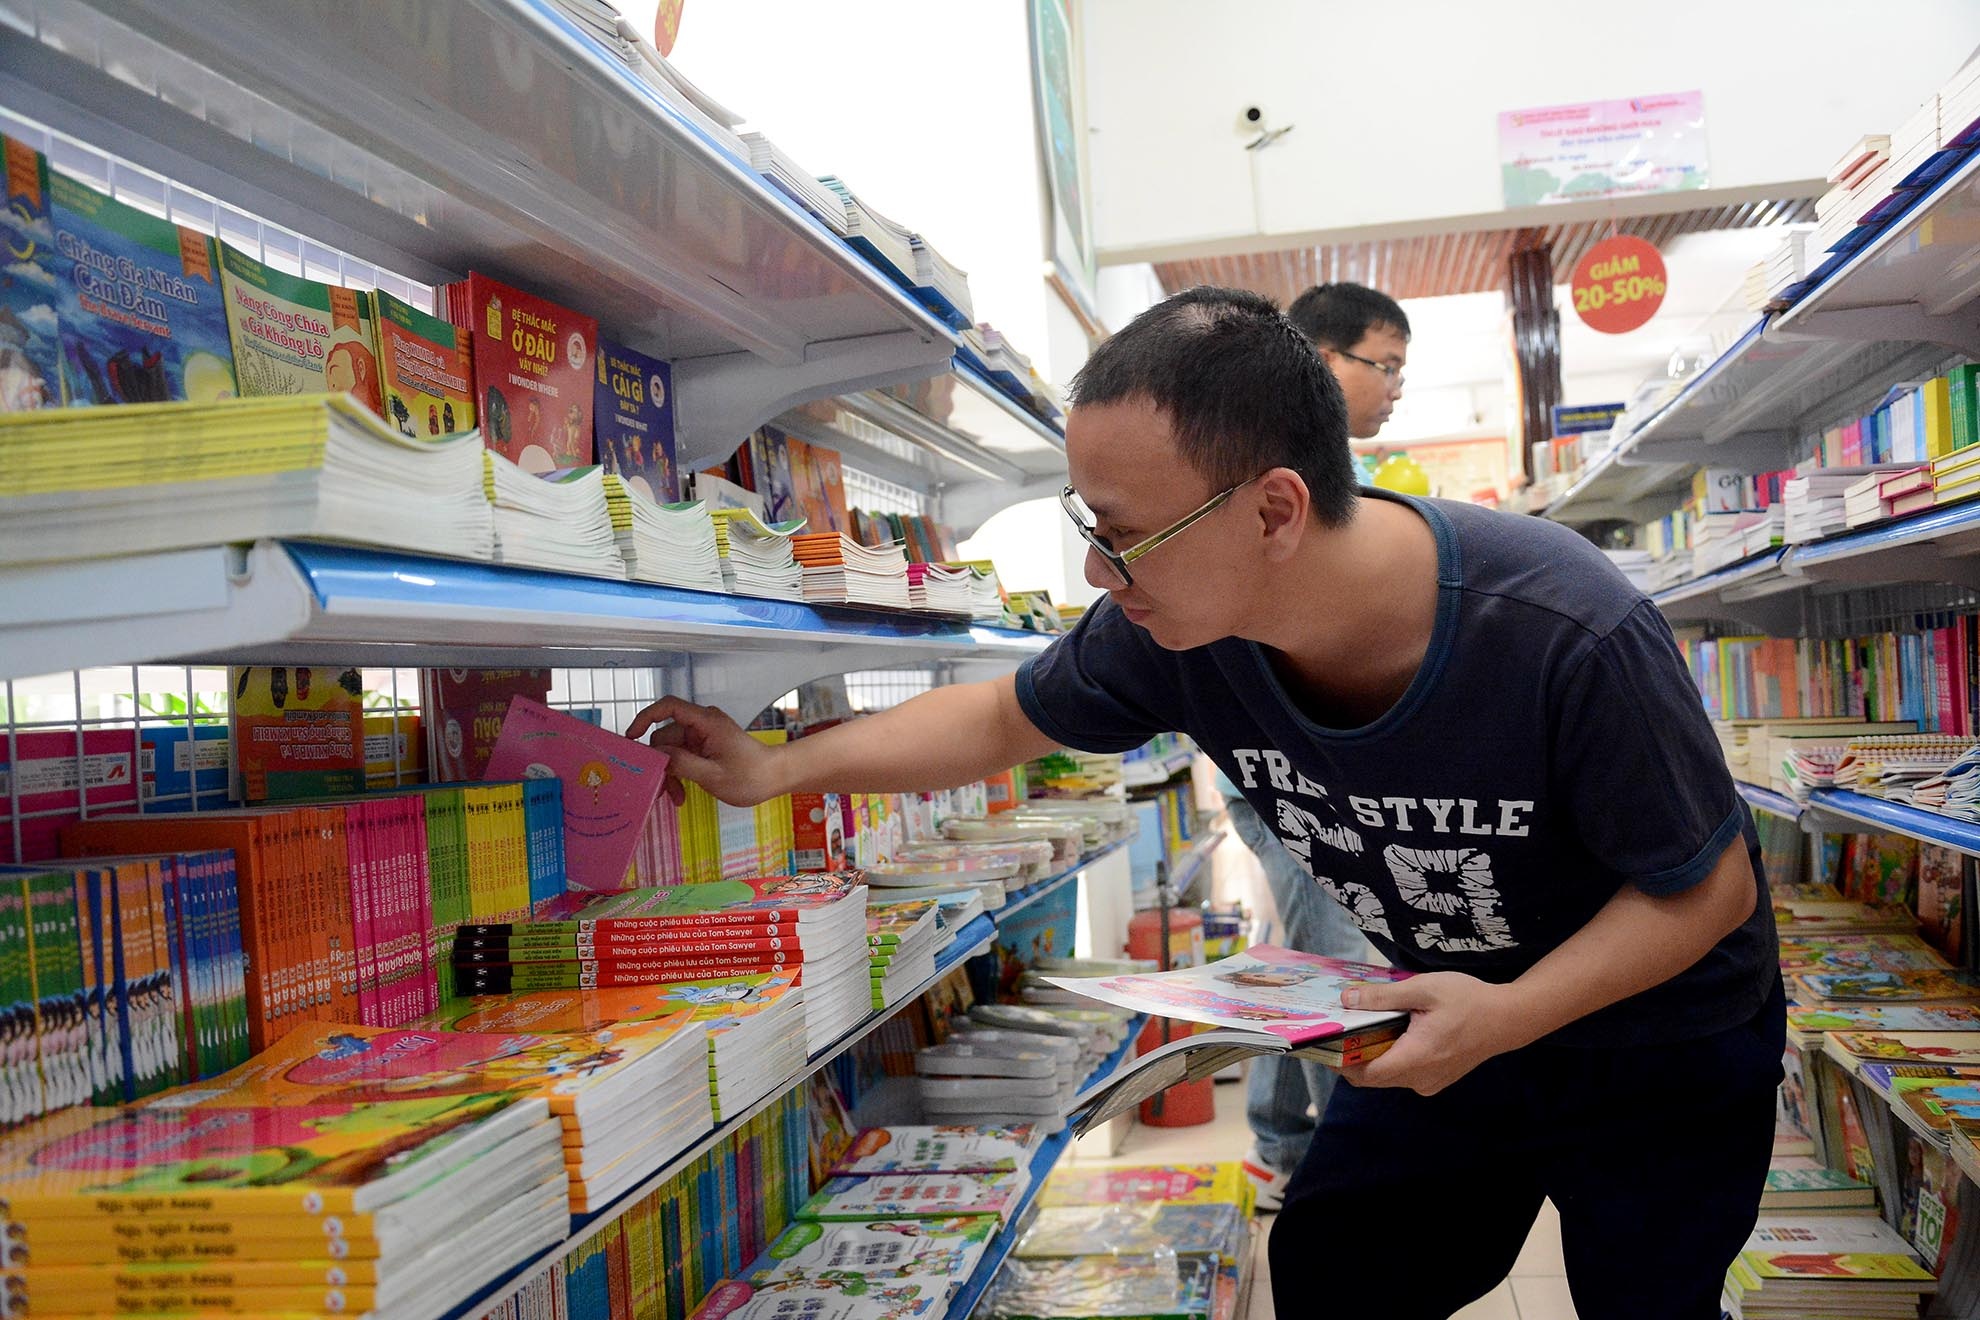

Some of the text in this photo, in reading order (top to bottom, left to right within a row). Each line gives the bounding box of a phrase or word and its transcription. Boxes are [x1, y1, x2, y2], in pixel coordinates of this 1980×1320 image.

[58, 231, 117, 280] Chàng
[74, 264, 118, 305] Can
[1574, 274, 1665, 312] 20-50%
[235, 286, 264, 319] Nàng
[262, 301, 295, 333] Công
[294, 314, 330, 338] Chúa
[512, 323, 555, 363] Ở ĐÂU
[512, 374, 537, 392] WONDER
[537, 382, 559, 398] WHERE
[613, 372, 630, 398] CÁI
[1348, 794, 1535, 837] STYLE
[614, 919, 637, 929] Những
[639, 919, 659, 928] cuộc
[682, 918, 694, 926] lưu
[695, 916, 709, 925] của
[712, 916, 726, 924] Tom
[728, 915, 755, 925] Sawyer
[611, 932, 635, 943] Những
[636, 933, 655, 941] cuộc
[679, 931, 691, 939] lưu
[692, 929, 707, 938] của
[709, 929, 724, 937] Tom
[726, 928, 753, 938] Sawyer
[613, 946, 636, 956] Những
[638, 947, 657, 955] cuộc
[682, 945, 693, 953] lưu
[695, 943, 709, 952] của
[712, 942, 726, 951] Tom
[728, 941, 756, 952] Sawyer
[614, 973, 639, 983] Những
[640, 973, 659, 982] cuộc
[684, 971, 695, 979] lưu
[697, 969, 711, 979] của
[713, 969, 729, 978] Tom
[730, 968, 758, 976] Sawyer
[617, 960, 641, 971] Những
[642, 960, 662, 969] cuộc
[686, 958, 697, 966] lưu
[699, 956, 714, 966] của
[716, 957, 731, 965] Tom
[732, 955, 760, 965] Sawyer
